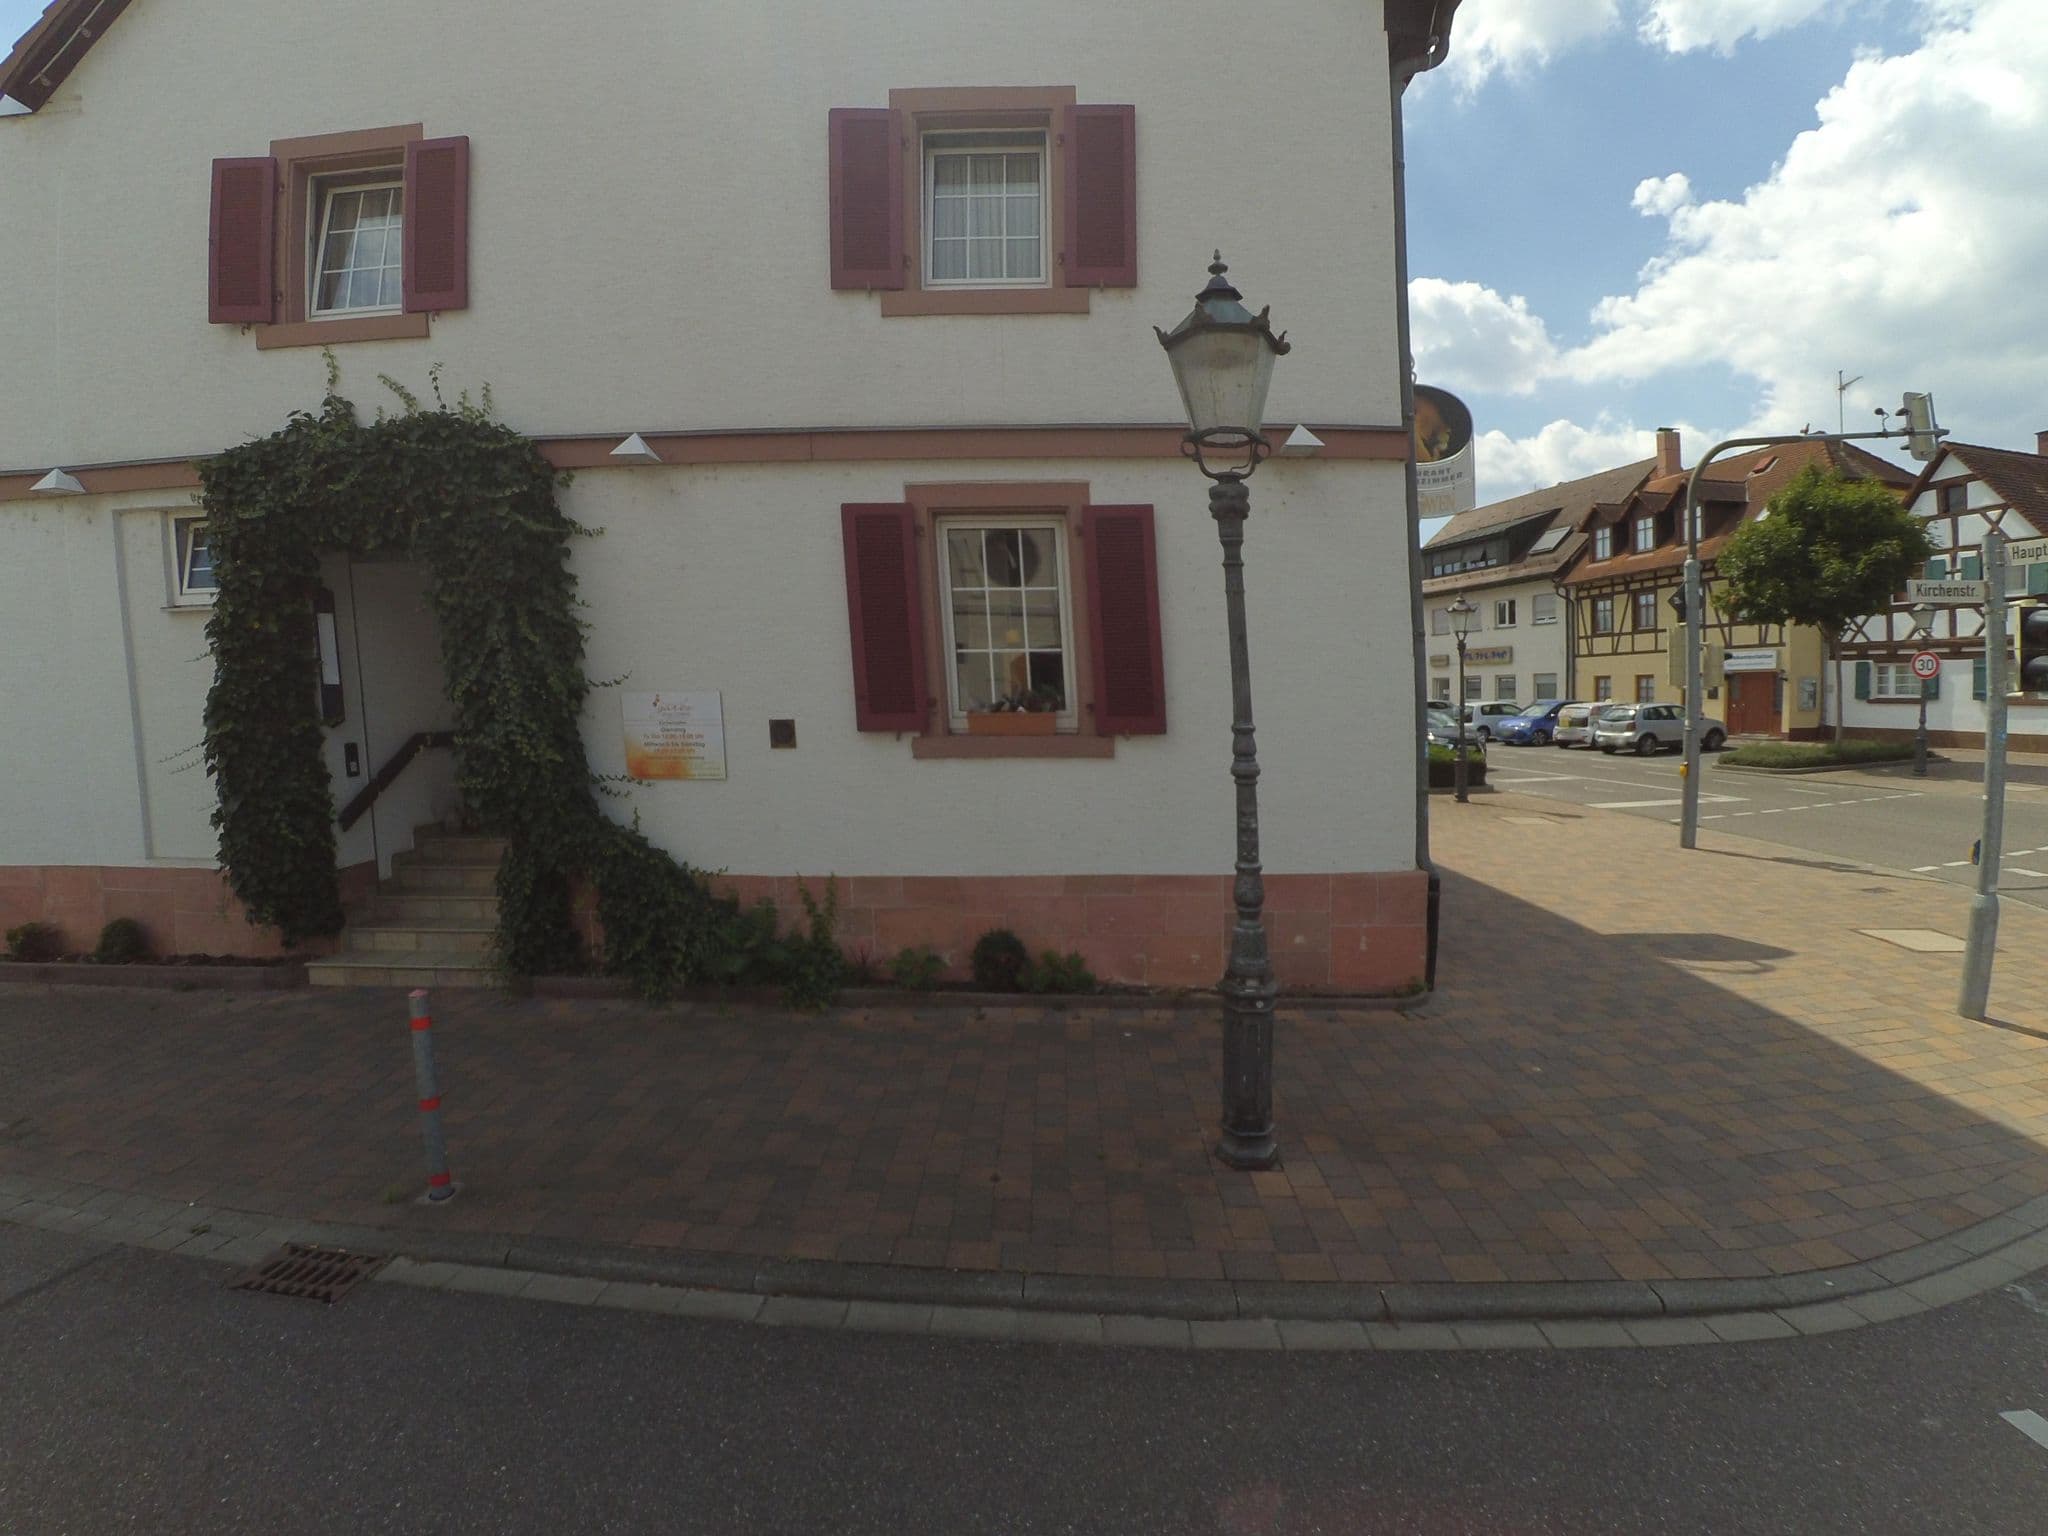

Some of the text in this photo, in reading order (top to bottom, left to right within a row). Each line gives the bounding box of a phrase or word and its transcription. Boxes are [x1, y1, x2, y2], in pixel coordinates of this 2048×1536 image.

[2012, 544, 2048, 560] Haupt
[1916, 583, 1978, 597] Kirchenstr.
[1918, 659, 1934, 671] 30
